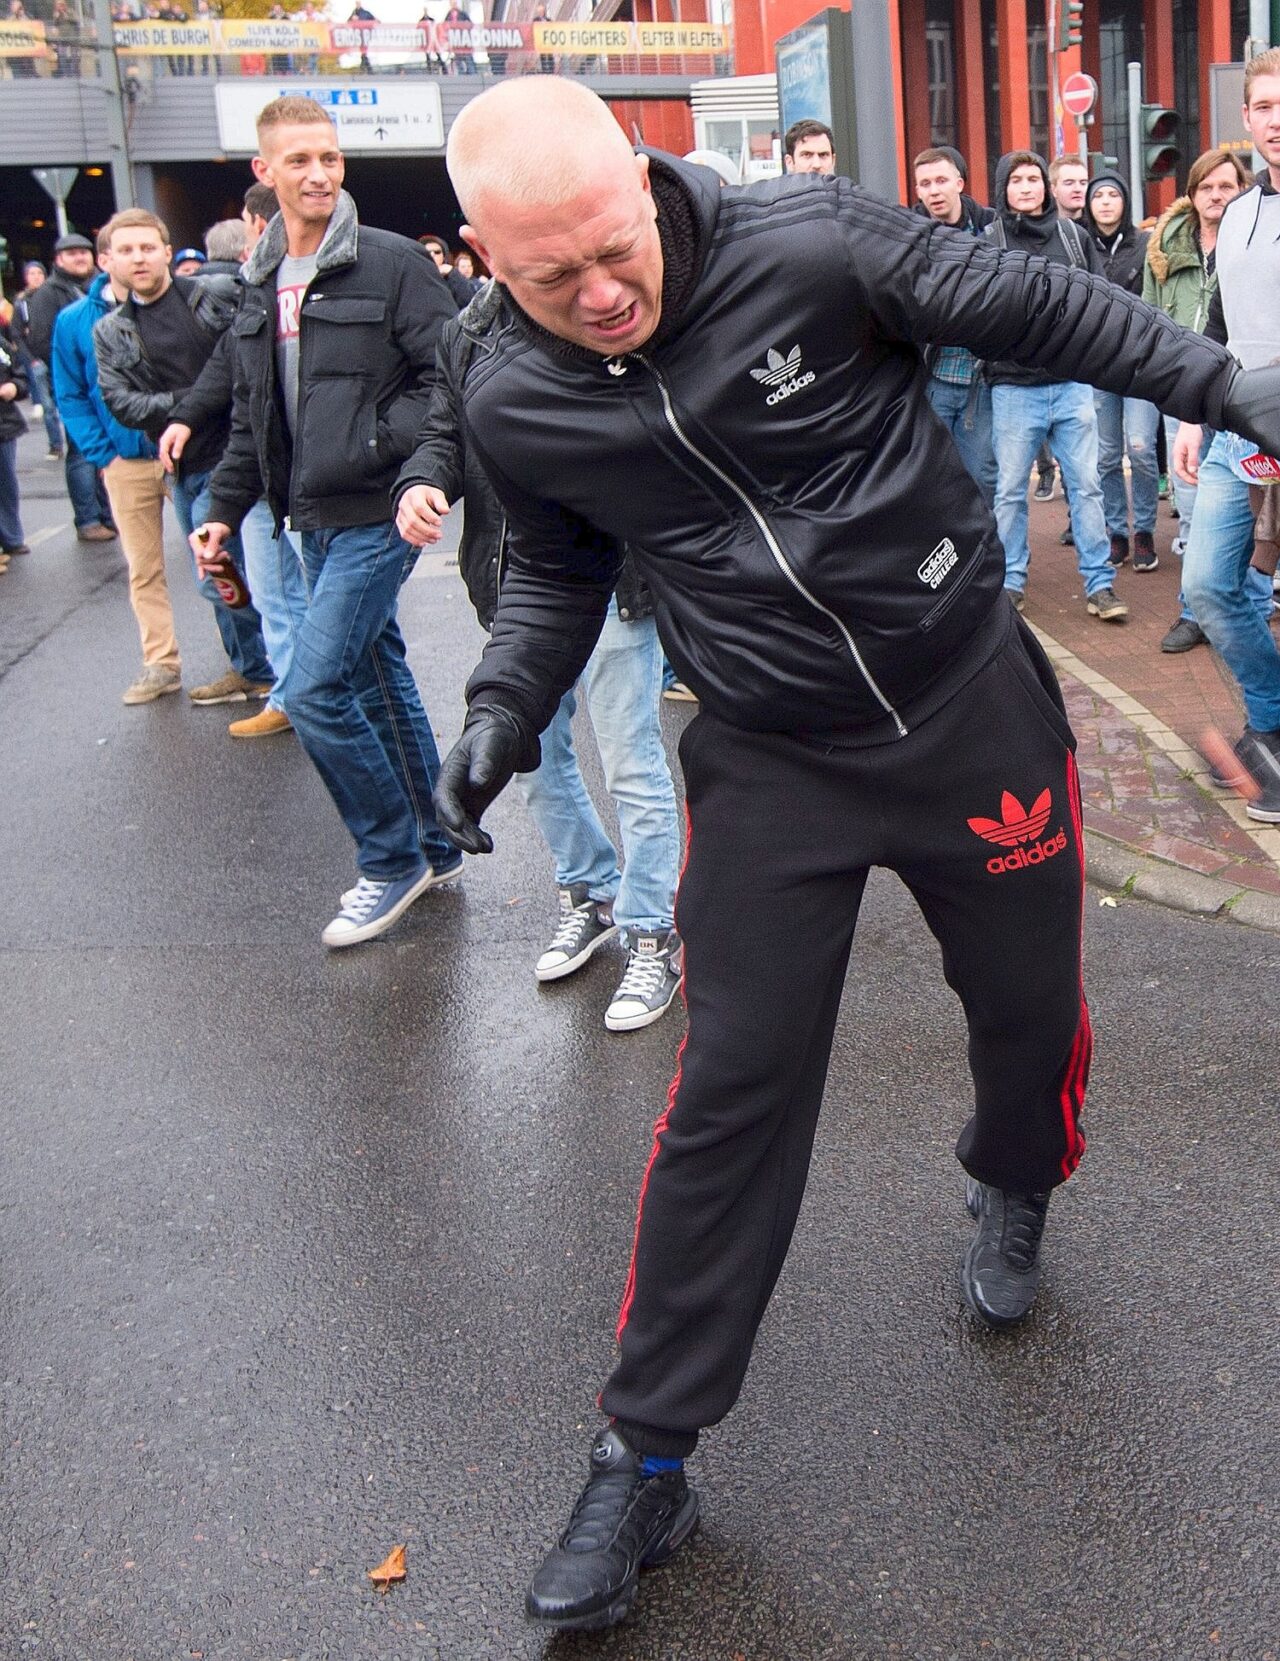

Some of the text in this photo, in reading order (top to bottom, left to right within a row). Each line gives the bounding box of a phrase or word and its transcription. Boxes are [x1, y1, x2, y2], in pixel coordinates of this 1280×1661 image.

[114, 30, 209, 46] CHRIS DE BURGH
[303, 37, 320, 48] XXL
[449, 29, 524, 48] MADONNA
[543, 31, 627, 47] FOO FIGHTERS
[642, 32, 723, 48] ELFTER IM ELFTEN
[426, 115, 433, 123] 2
[766, 370, 816, 406] adidas
[1244, 456, 1277, 477] Vittel
[922, 541, 951, 578] adidas
[986, 826, 1067, 874] adidas
